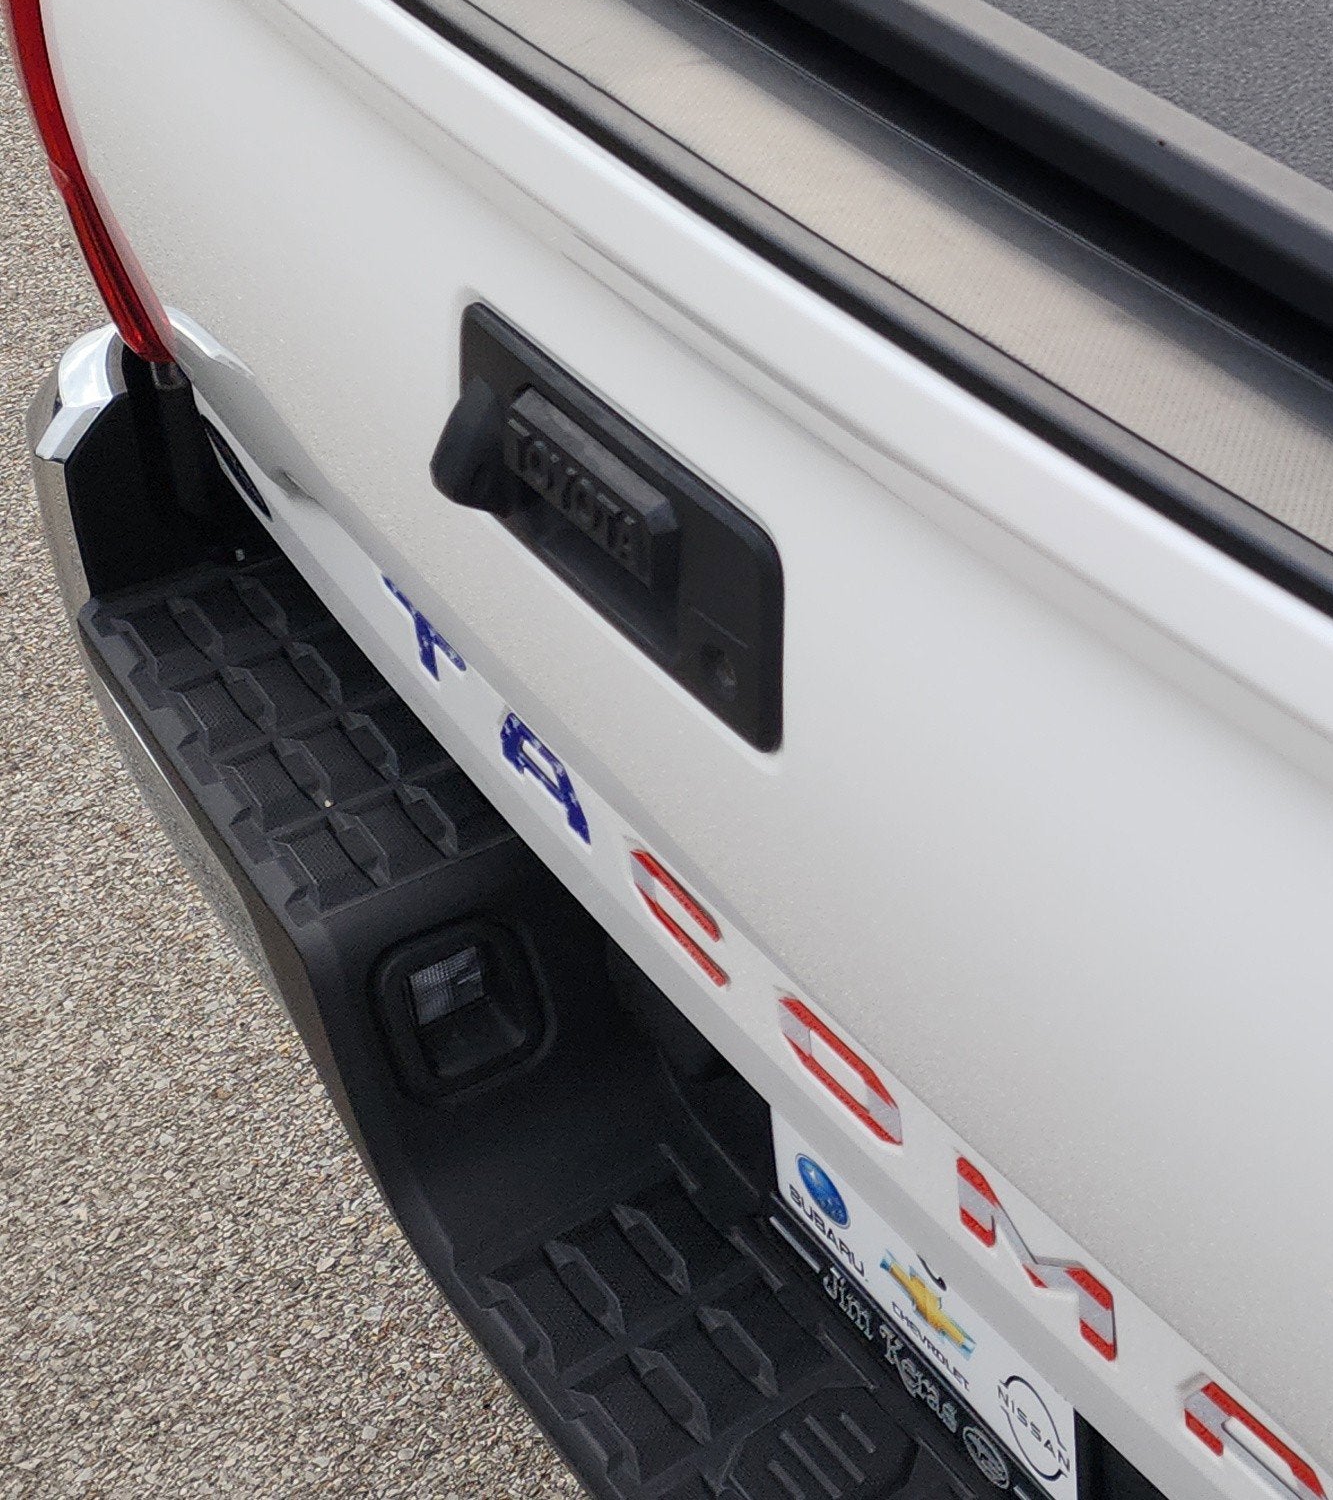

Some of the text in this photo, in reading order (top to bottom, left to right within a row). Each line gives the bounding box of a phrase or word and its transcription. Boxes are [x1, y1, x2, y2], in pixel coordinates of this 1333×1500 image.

[503, 417, 641, 568] TOYOTA
[788, 1183, 866, 1278] SUBARU
[823, 1266, 957, 1434] Jim Keras
[891, 1300, 970, 1393] CHEVROLET
[997, 1382, 1071, 1472] NISSAN
